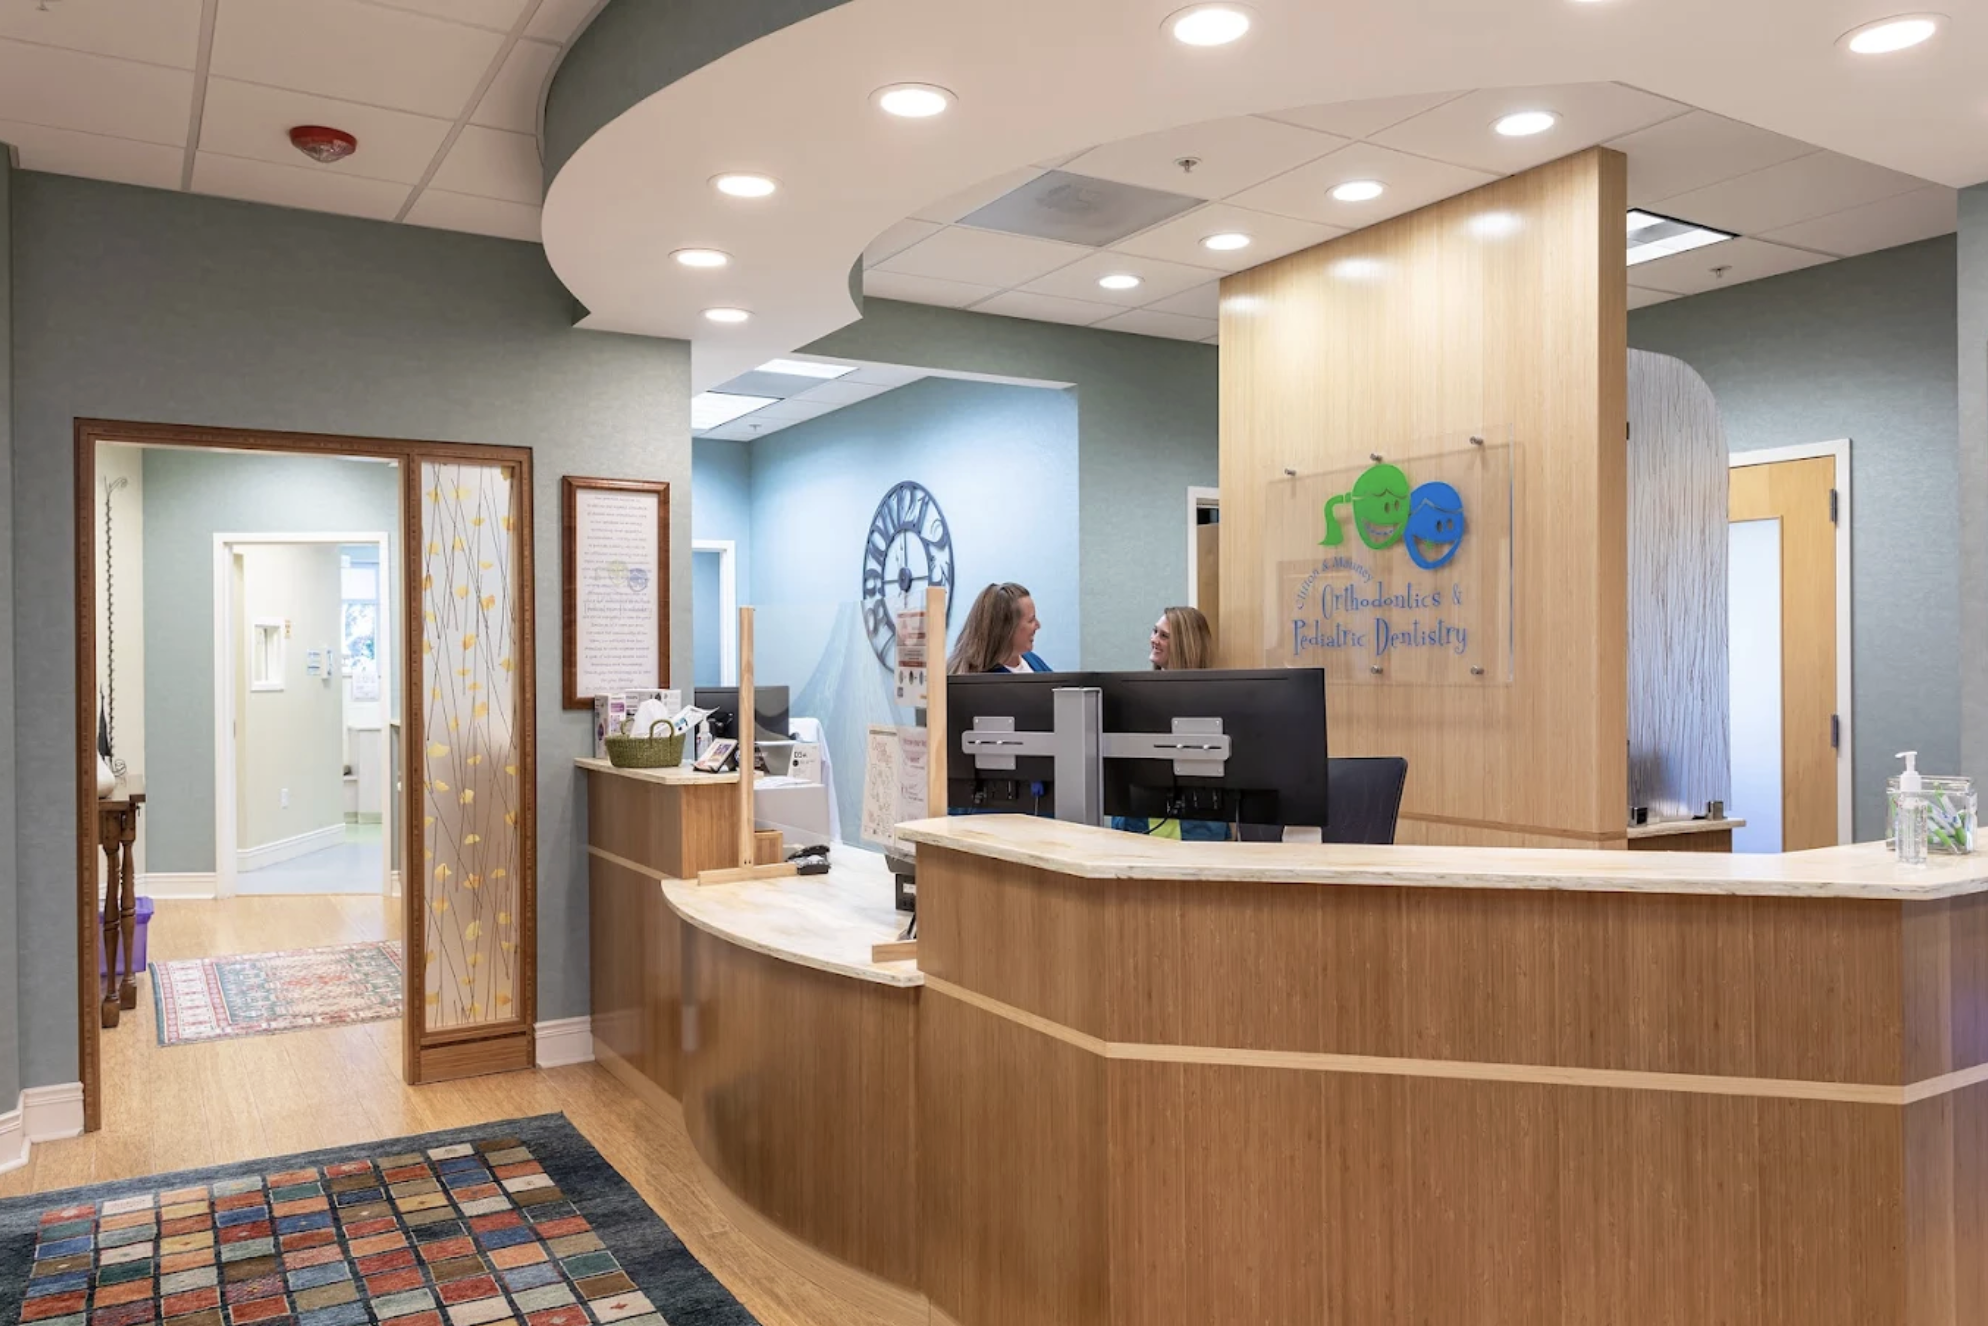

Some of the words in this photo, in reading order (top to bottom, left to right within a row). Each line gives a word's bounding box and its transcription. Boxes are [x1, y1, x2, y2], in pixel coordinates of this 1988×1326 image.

[1322, 581, 1441, 620] Orthodontics
[1452, 583, 1463, 605] &
[1292, 619, 1367, 656] Pediatric
[1375, 617, 1468, 657] Dentistry
